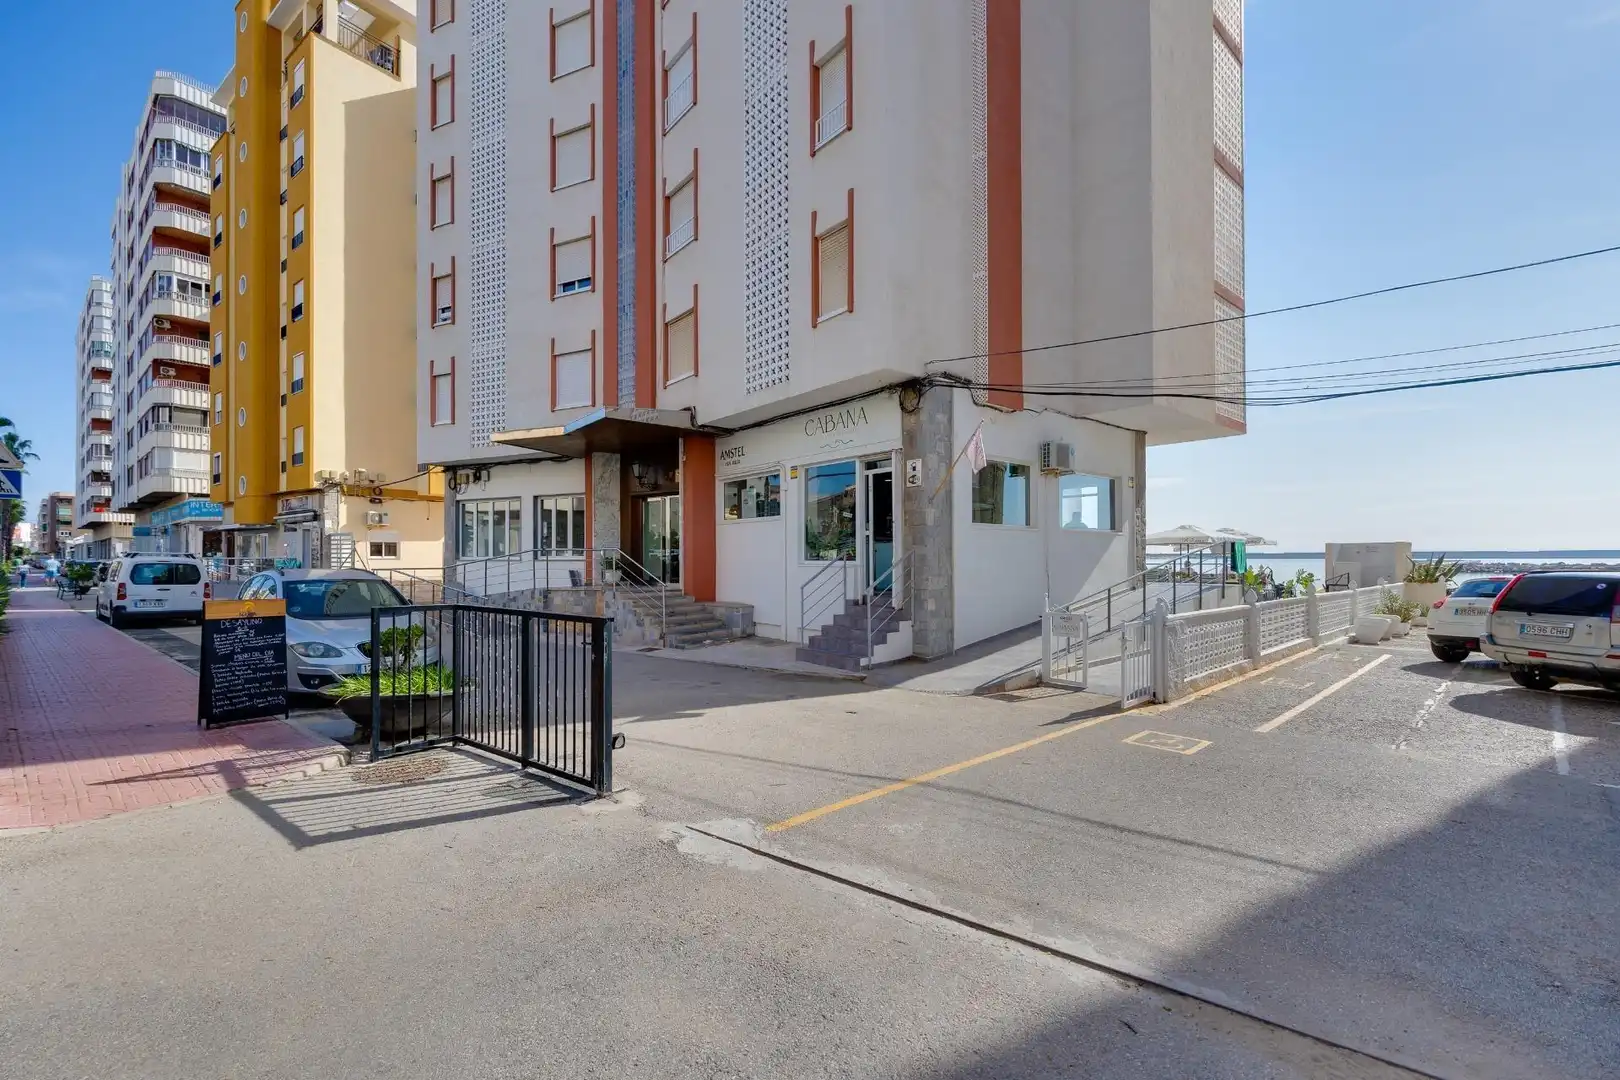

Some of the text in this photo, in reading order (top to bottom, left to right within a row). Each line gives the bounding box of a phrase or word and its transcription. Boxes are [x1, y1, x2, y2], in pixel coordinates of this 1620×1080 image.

[804, 406, 868, 436] CABANA
[720, 446, 746, 460] AMSTEL
[220, 618, 263, 628] DESAYUNO
[1526, 624, 1569, 636] 0596 CHH
